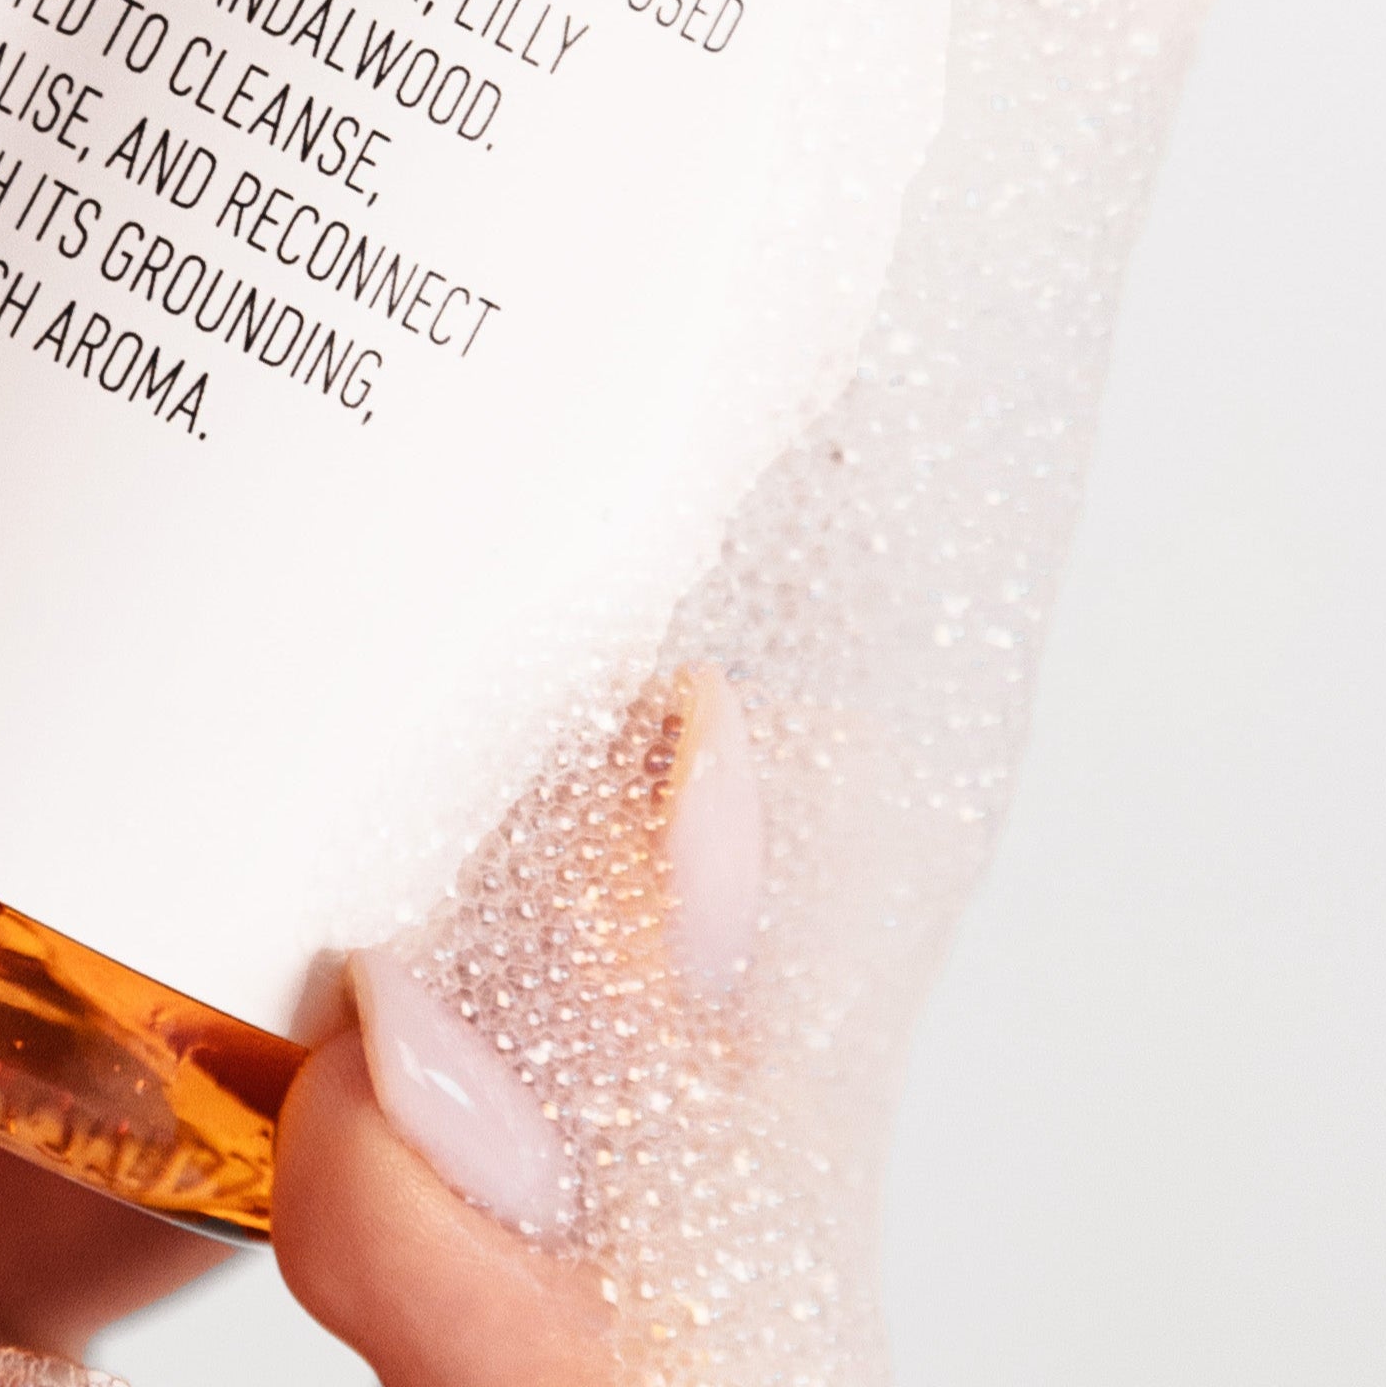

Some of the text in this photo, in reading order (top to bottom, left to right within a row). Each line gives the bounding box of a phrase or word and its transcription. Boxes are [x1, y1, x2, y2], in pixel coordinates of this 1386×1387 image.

[167, 34, 393, 209] CLEANSE,
[13, 172, 104, 261] ITS
[98, 219, 384, 426] GROUNDING,
[102, 115, 219, 211] AND
[214, 169, 502, 357] RECONNECT
[31, 298, 210, 442] AROMA.
